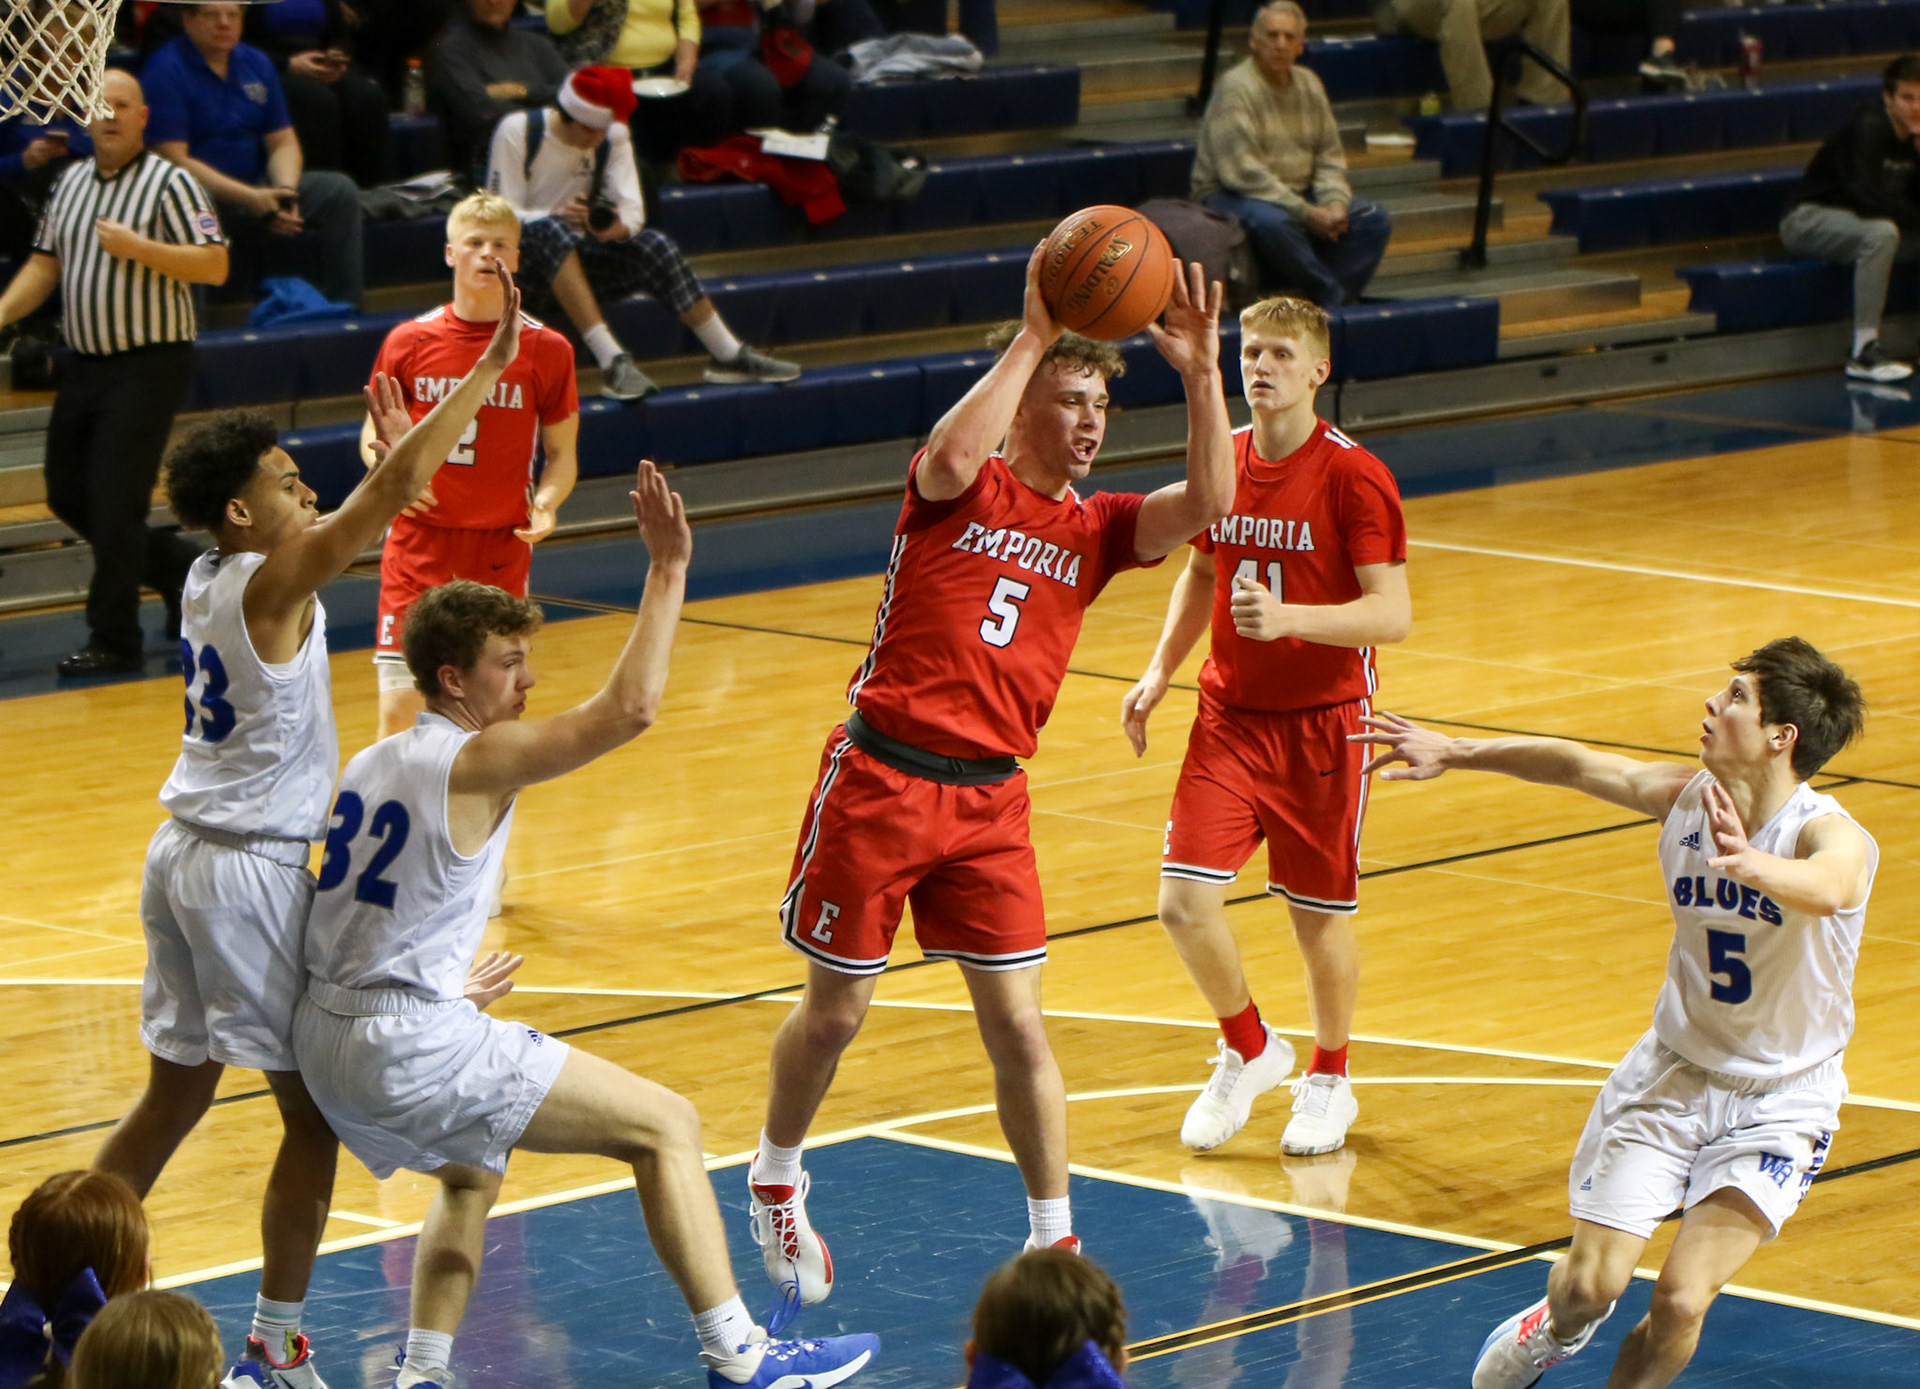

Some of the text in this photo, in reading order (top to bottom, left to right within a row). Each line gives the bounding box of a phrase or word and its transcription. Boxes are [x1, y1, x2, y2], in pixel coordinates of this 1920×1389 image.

[1067, 233, 1133, 310] SPALDING
[952, 521, 1082, 588] EMPORIA
[1231, 557, 1284, 605] 41
[380, 614, 395, 646] E
[979, 575, 1032, 648] 5
[316, 789, 411, 911] 32
[810, 899, 841, 945] E
[1673, 876, 1783, 927] BLUES
[1706, 928, 1753, 1005] 5
